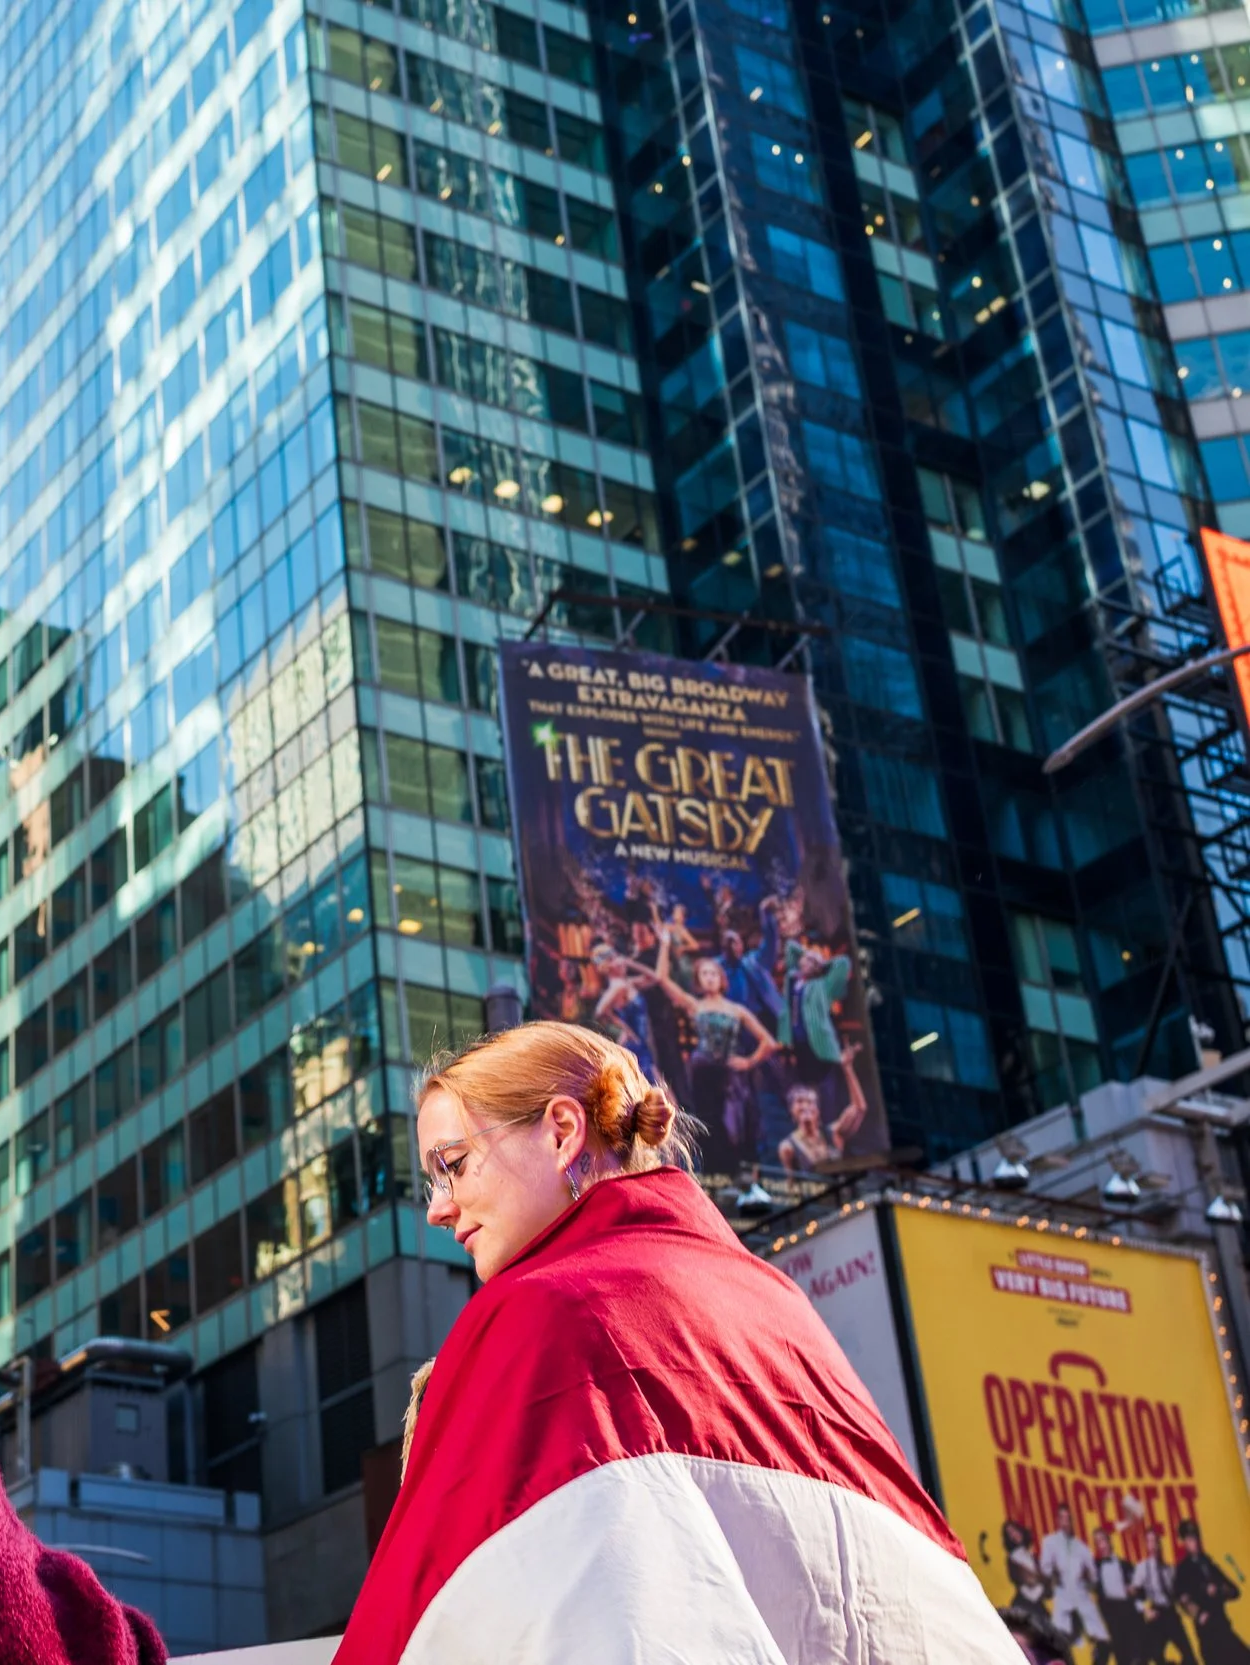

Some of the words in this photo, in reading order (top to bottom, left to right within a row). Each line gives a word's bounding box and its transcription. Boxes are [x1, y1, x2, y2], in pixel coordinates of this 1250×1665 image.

[577, 683, 746, 722] EXTRAVAGANZA
[628, 671, 666, 693] BIG
[671, 677, 788, 709] BROADWAY
[542, 731, 626, 788] THE
[634, 742, 794, 808] GREAT
[574, 786, 774, 855] GATSBY
[631, 845, 672, 863] NEW
[673, 849, 750, 871] MUSICAL
[983, 1372, 1193, 1480] OPERATION
